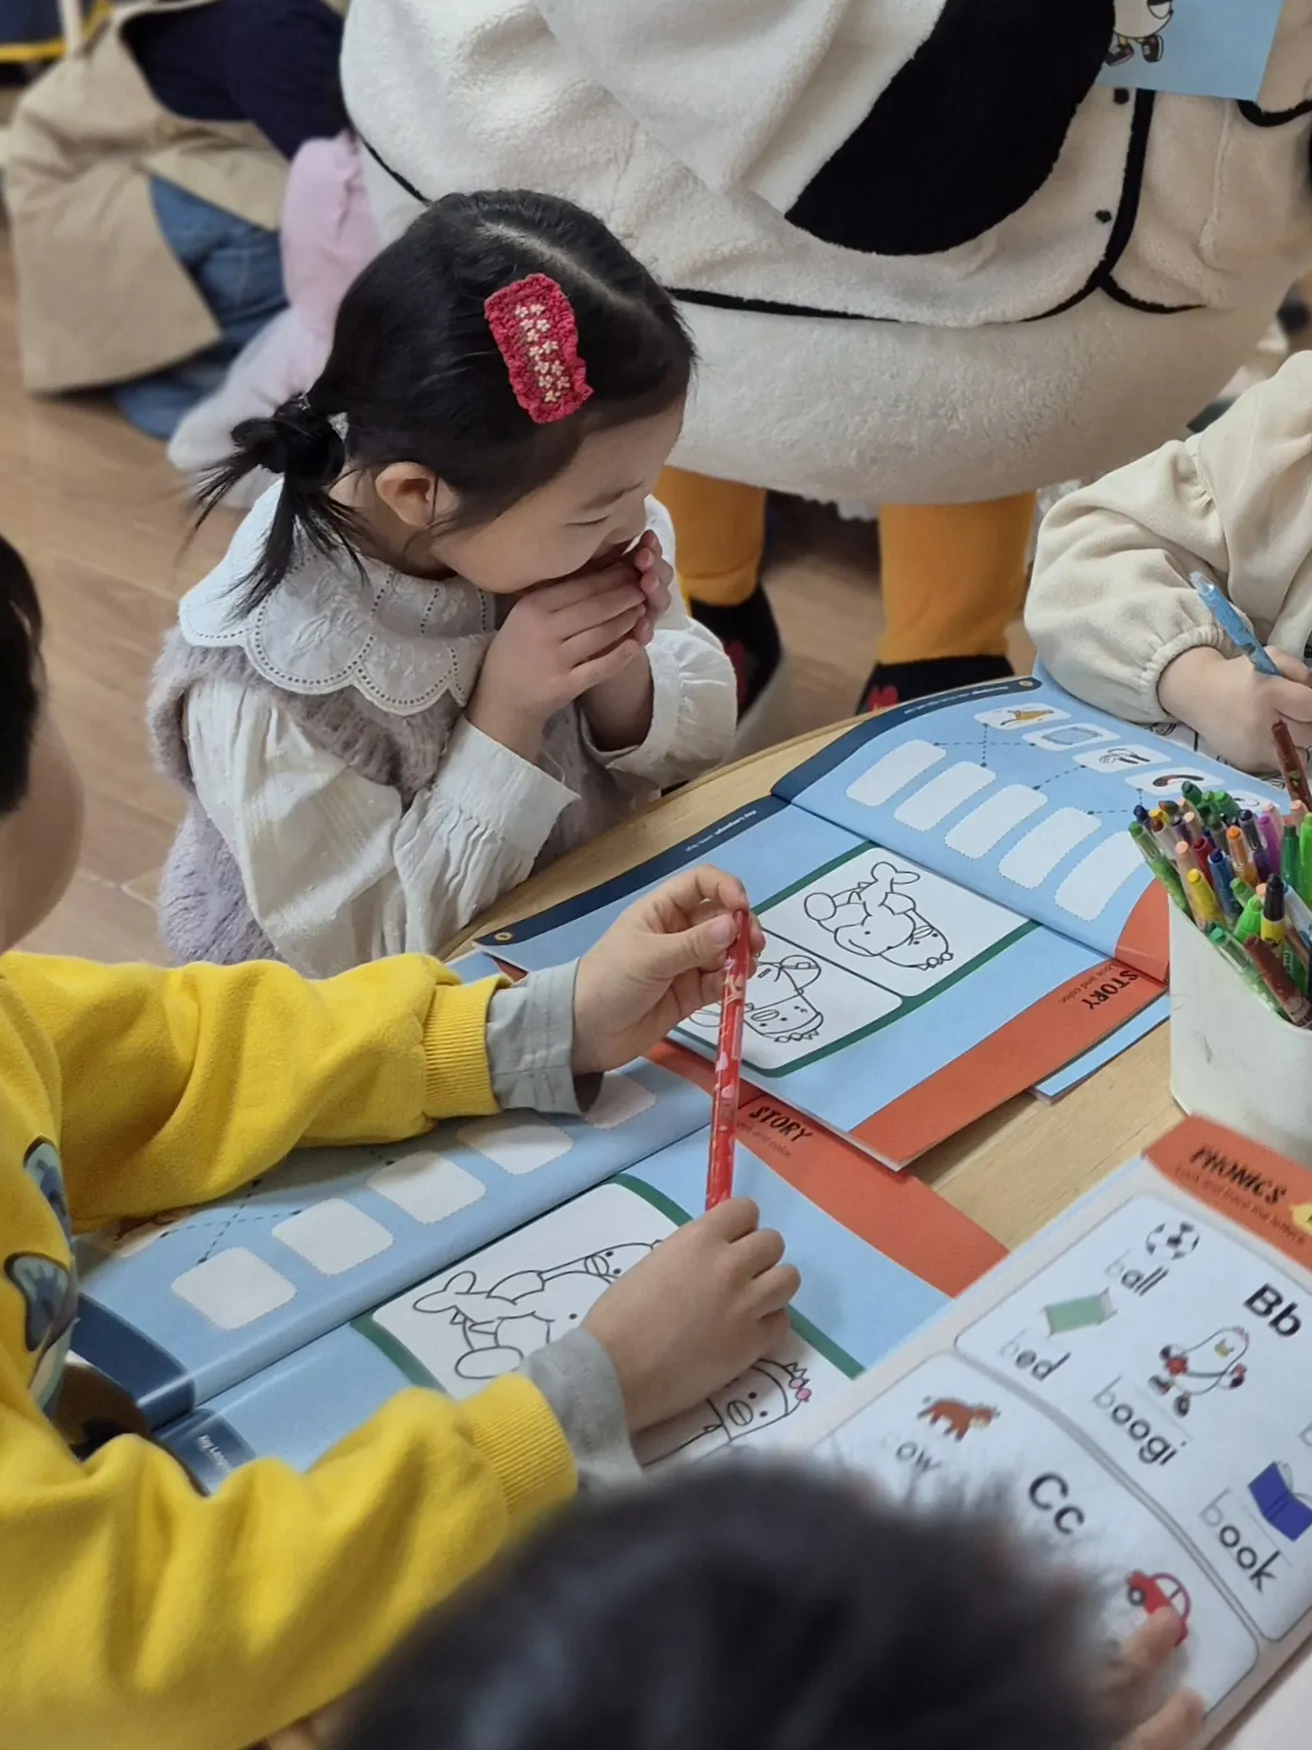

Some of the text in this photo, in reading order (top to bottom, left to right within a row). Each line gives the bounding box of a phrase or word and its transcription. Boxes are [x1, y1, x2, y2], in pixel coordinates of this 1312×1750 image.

[1082, 970, 1138, 1010] STORY
[749, 1106, 813, 1142] STORY
[1190, 1146, 1287, 1205] PHONICS
[1105, 1249, 1168, 1297] ball
[1244, 1282, 1303, 1339] Bb
[998, 1328, 1072, 1384] bed
[1091, 1375, 1180, 1467] boogi
[1028, 1472, 1085, 1536] Cc
[1198, 1488, 1280, 1592] book
